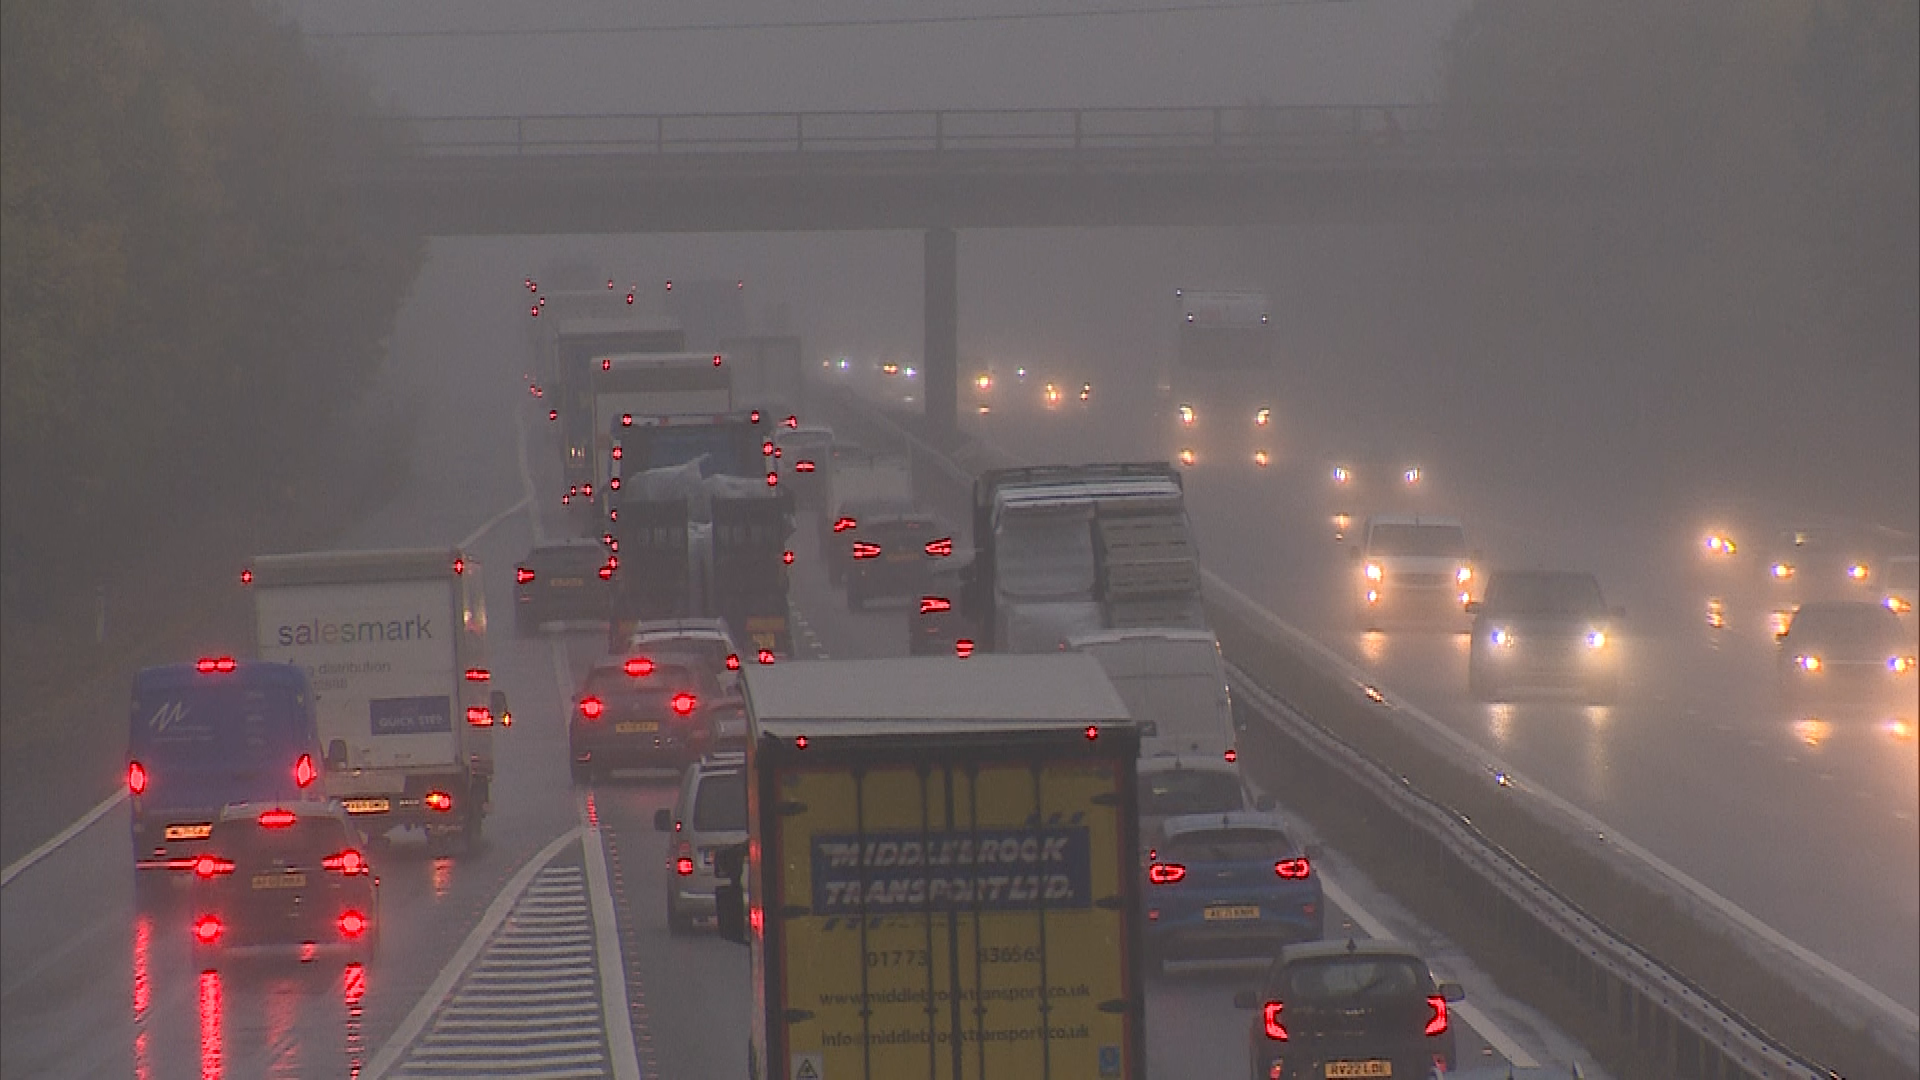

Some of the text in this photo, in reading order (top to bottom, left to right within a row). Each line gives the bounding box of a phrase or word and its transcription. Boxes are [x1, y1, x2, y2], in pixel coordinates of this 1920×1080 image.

[279, 614, 432, 646] salesmark
[318, 660, 391, 675] distribution
[825, 876, 1008, 905] TRANSPORT
[865, 950, 928, 968] 01773
[819, 983, 1091, 1005] wwwmiddleboktansportco.uk
